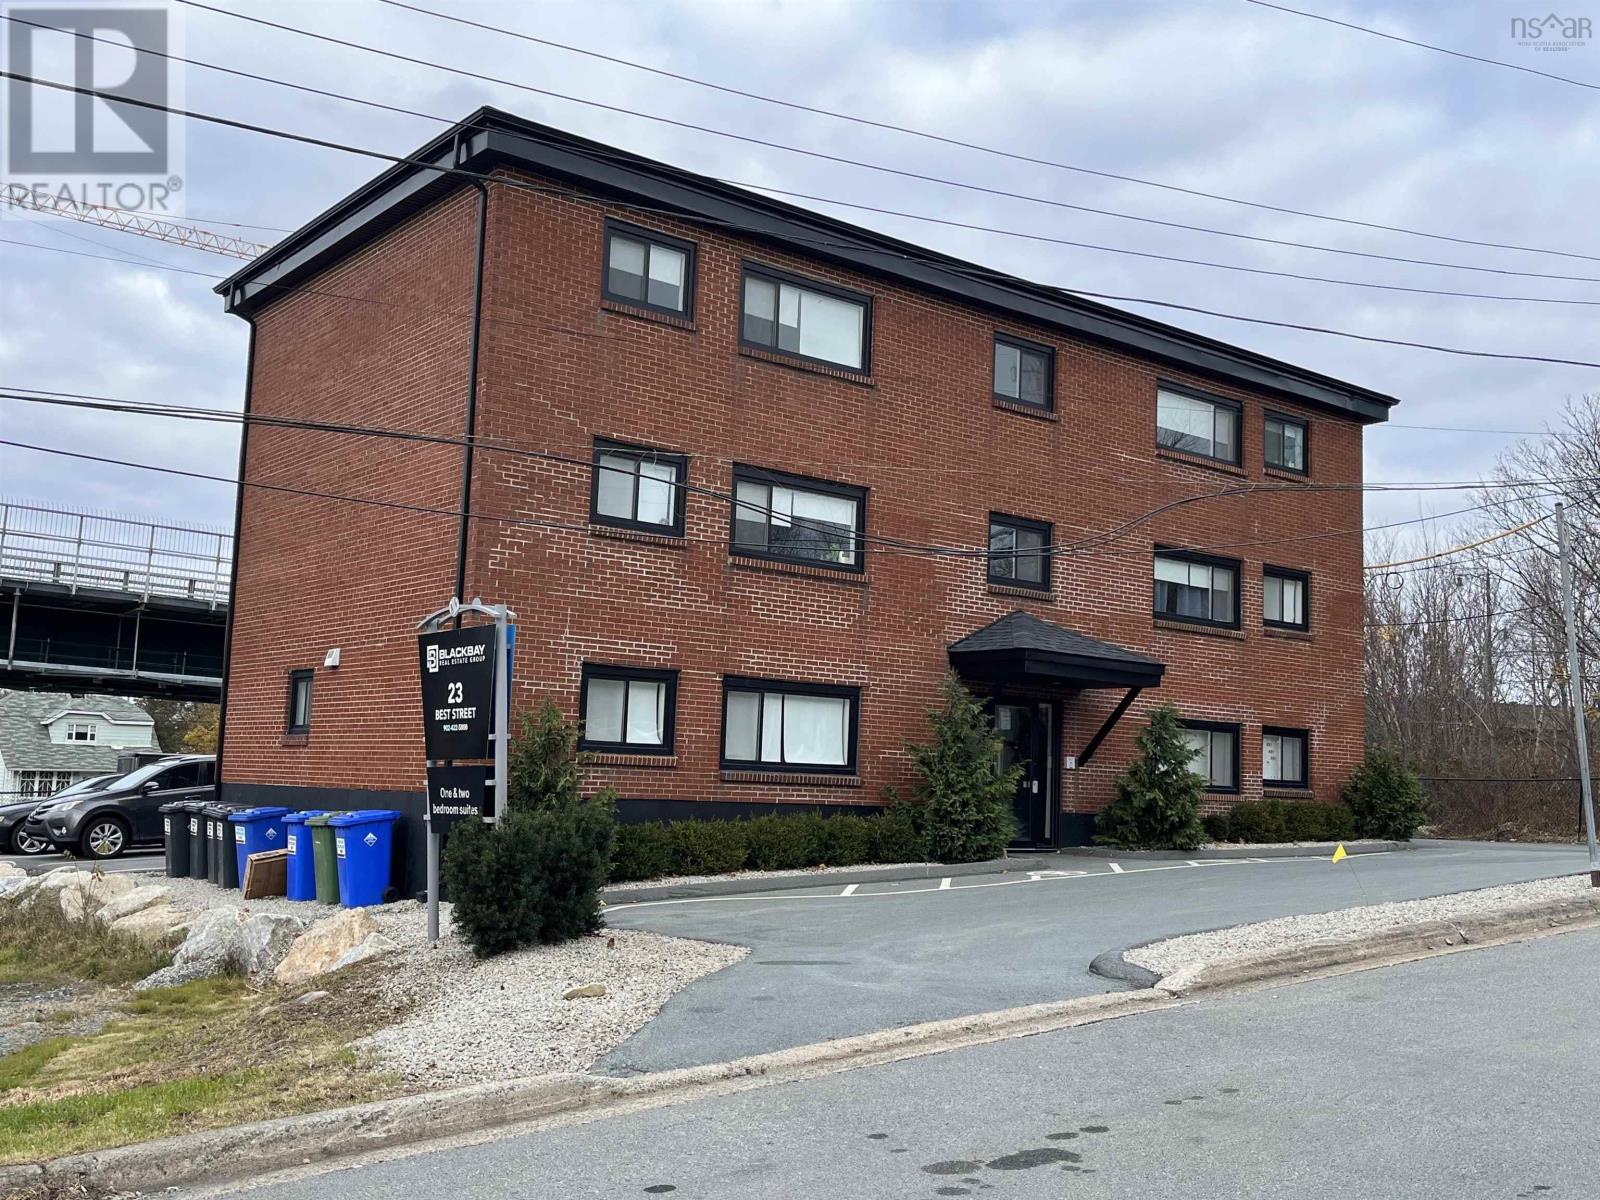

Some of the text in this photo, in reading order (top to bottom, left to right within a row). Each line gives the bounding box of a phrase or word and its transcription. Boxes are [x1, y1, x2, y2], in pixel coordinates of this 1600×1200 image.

[439, 644, 486, 659] BLACKBAY
[470, 655, 486, 663] GROUP
[448, 682, 463, 703] 23
[435, 707, 476, 721] BEST STREET
[440, 787, 470, 798] One & two
[433, 803, 478, 815] bedroom suites
